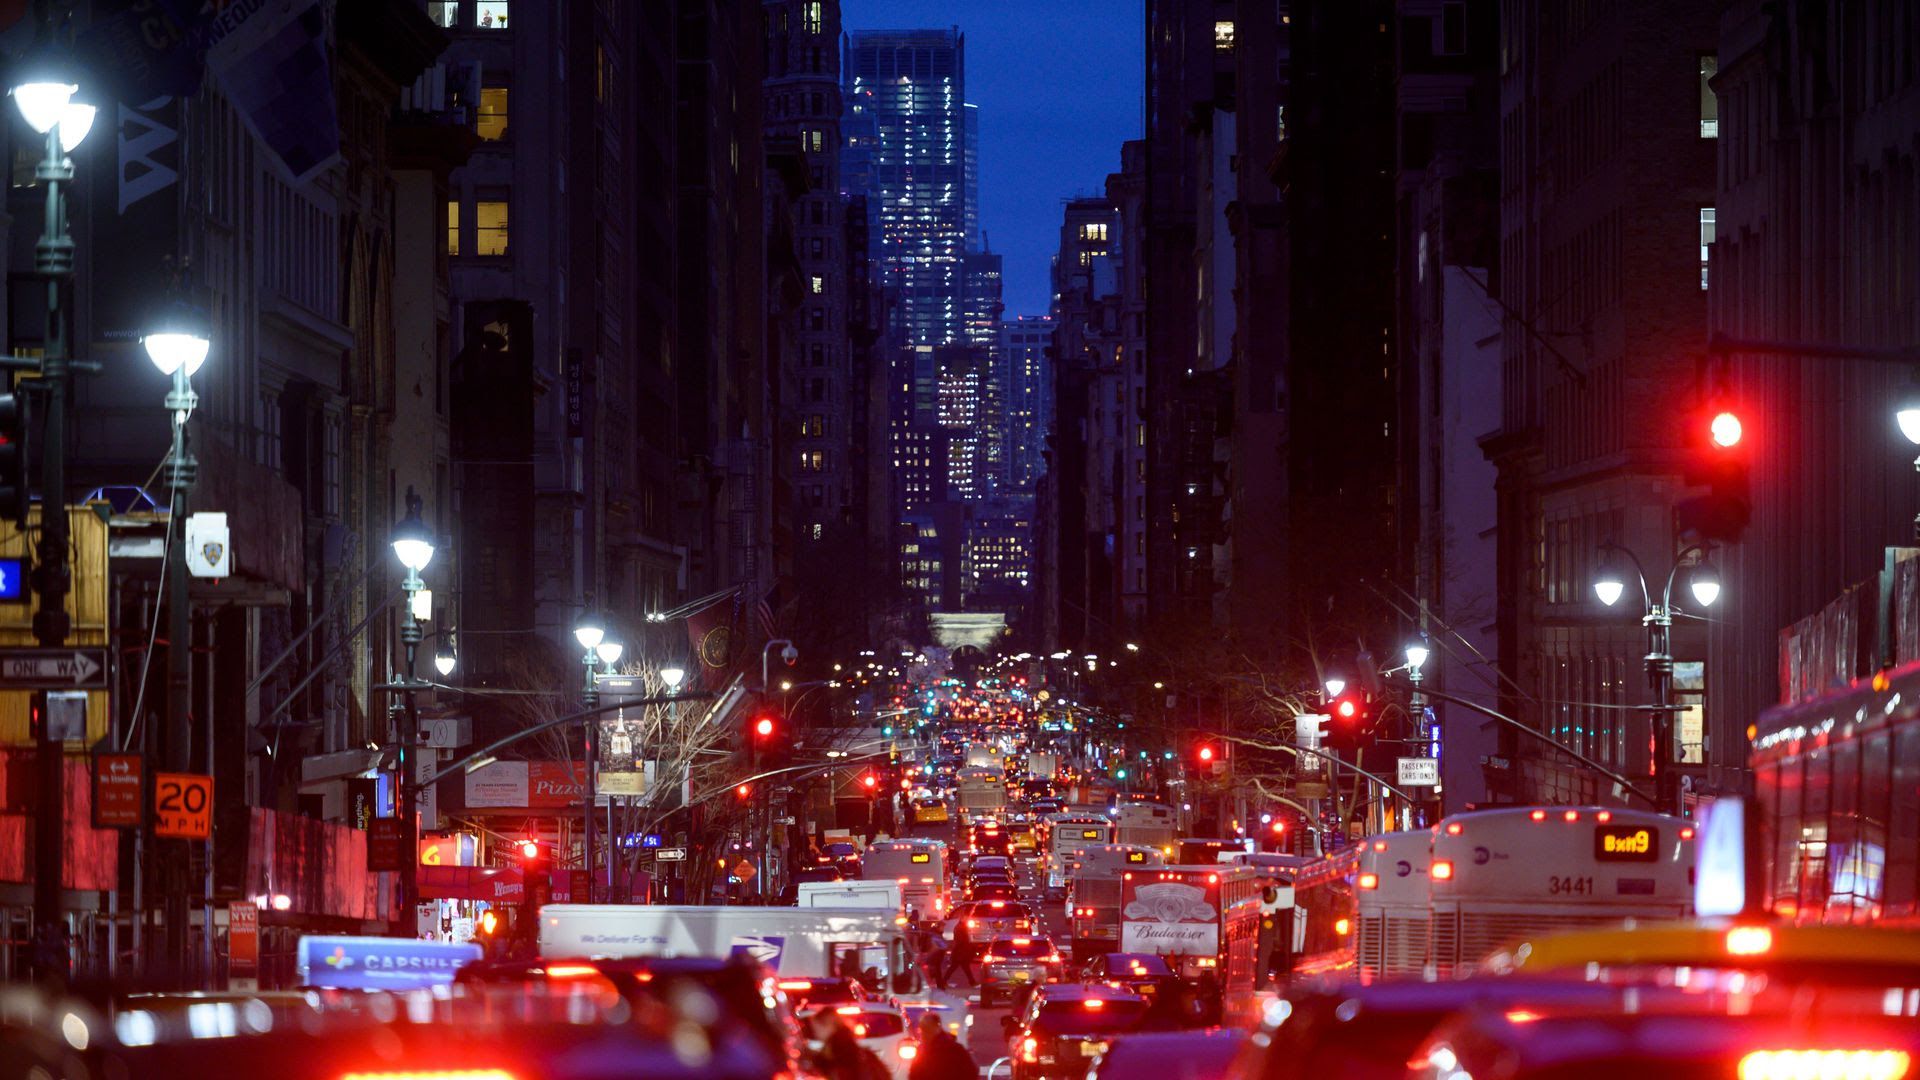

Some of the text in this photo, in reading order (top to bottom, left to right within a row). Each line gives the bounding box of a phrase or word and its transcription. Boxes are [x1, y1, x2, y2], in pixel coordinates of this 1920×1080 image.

[13, 661, 88, 674] ONE WAY
[160, 782, 206, 814] 20
[160, 817, 204, 832] MPH
[1549, 876, 1593, 895] 3441
[232, 912, 255, 921] NYC
[1133, 924, 1205, 939] Budweiser
